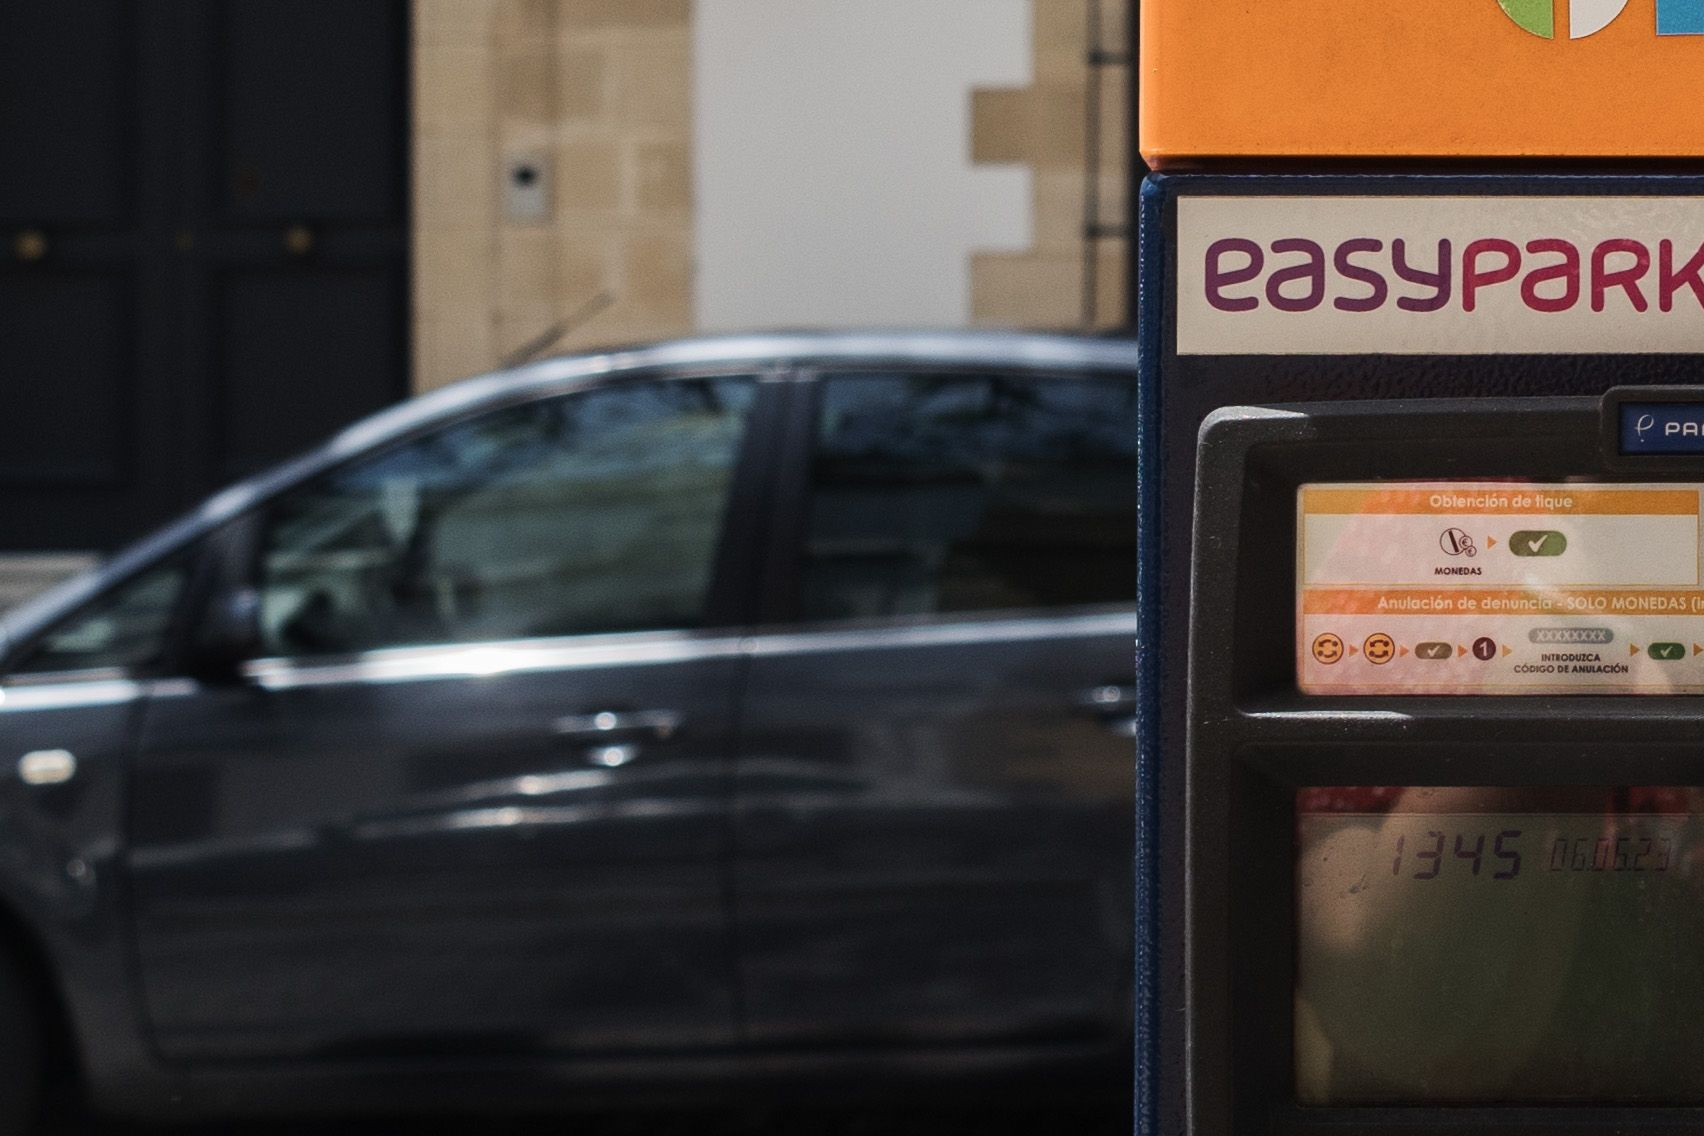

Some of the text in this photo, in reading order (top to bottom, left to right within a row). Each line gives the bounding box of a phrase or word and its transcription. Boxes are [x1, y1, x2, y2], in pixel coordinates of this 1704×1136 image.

[1430, 495, 1573, 510] Obtención de tique
[1434, 567, 1482, 576] MONEDAS
[1378, 596, 1452, 610] Anulación
[1457, 596, 1477, 610] de
[1481, 596, 1552, 610] denuncia
[1566, 596, 1606, 610] SOLO
[1611, 596, 1687, 610] MONEDAS
[1541, 653, 1601, 663] INTRODUZCA
[1514, 664, 1629, 674] CÓDIGO DE ANULACIÓN
